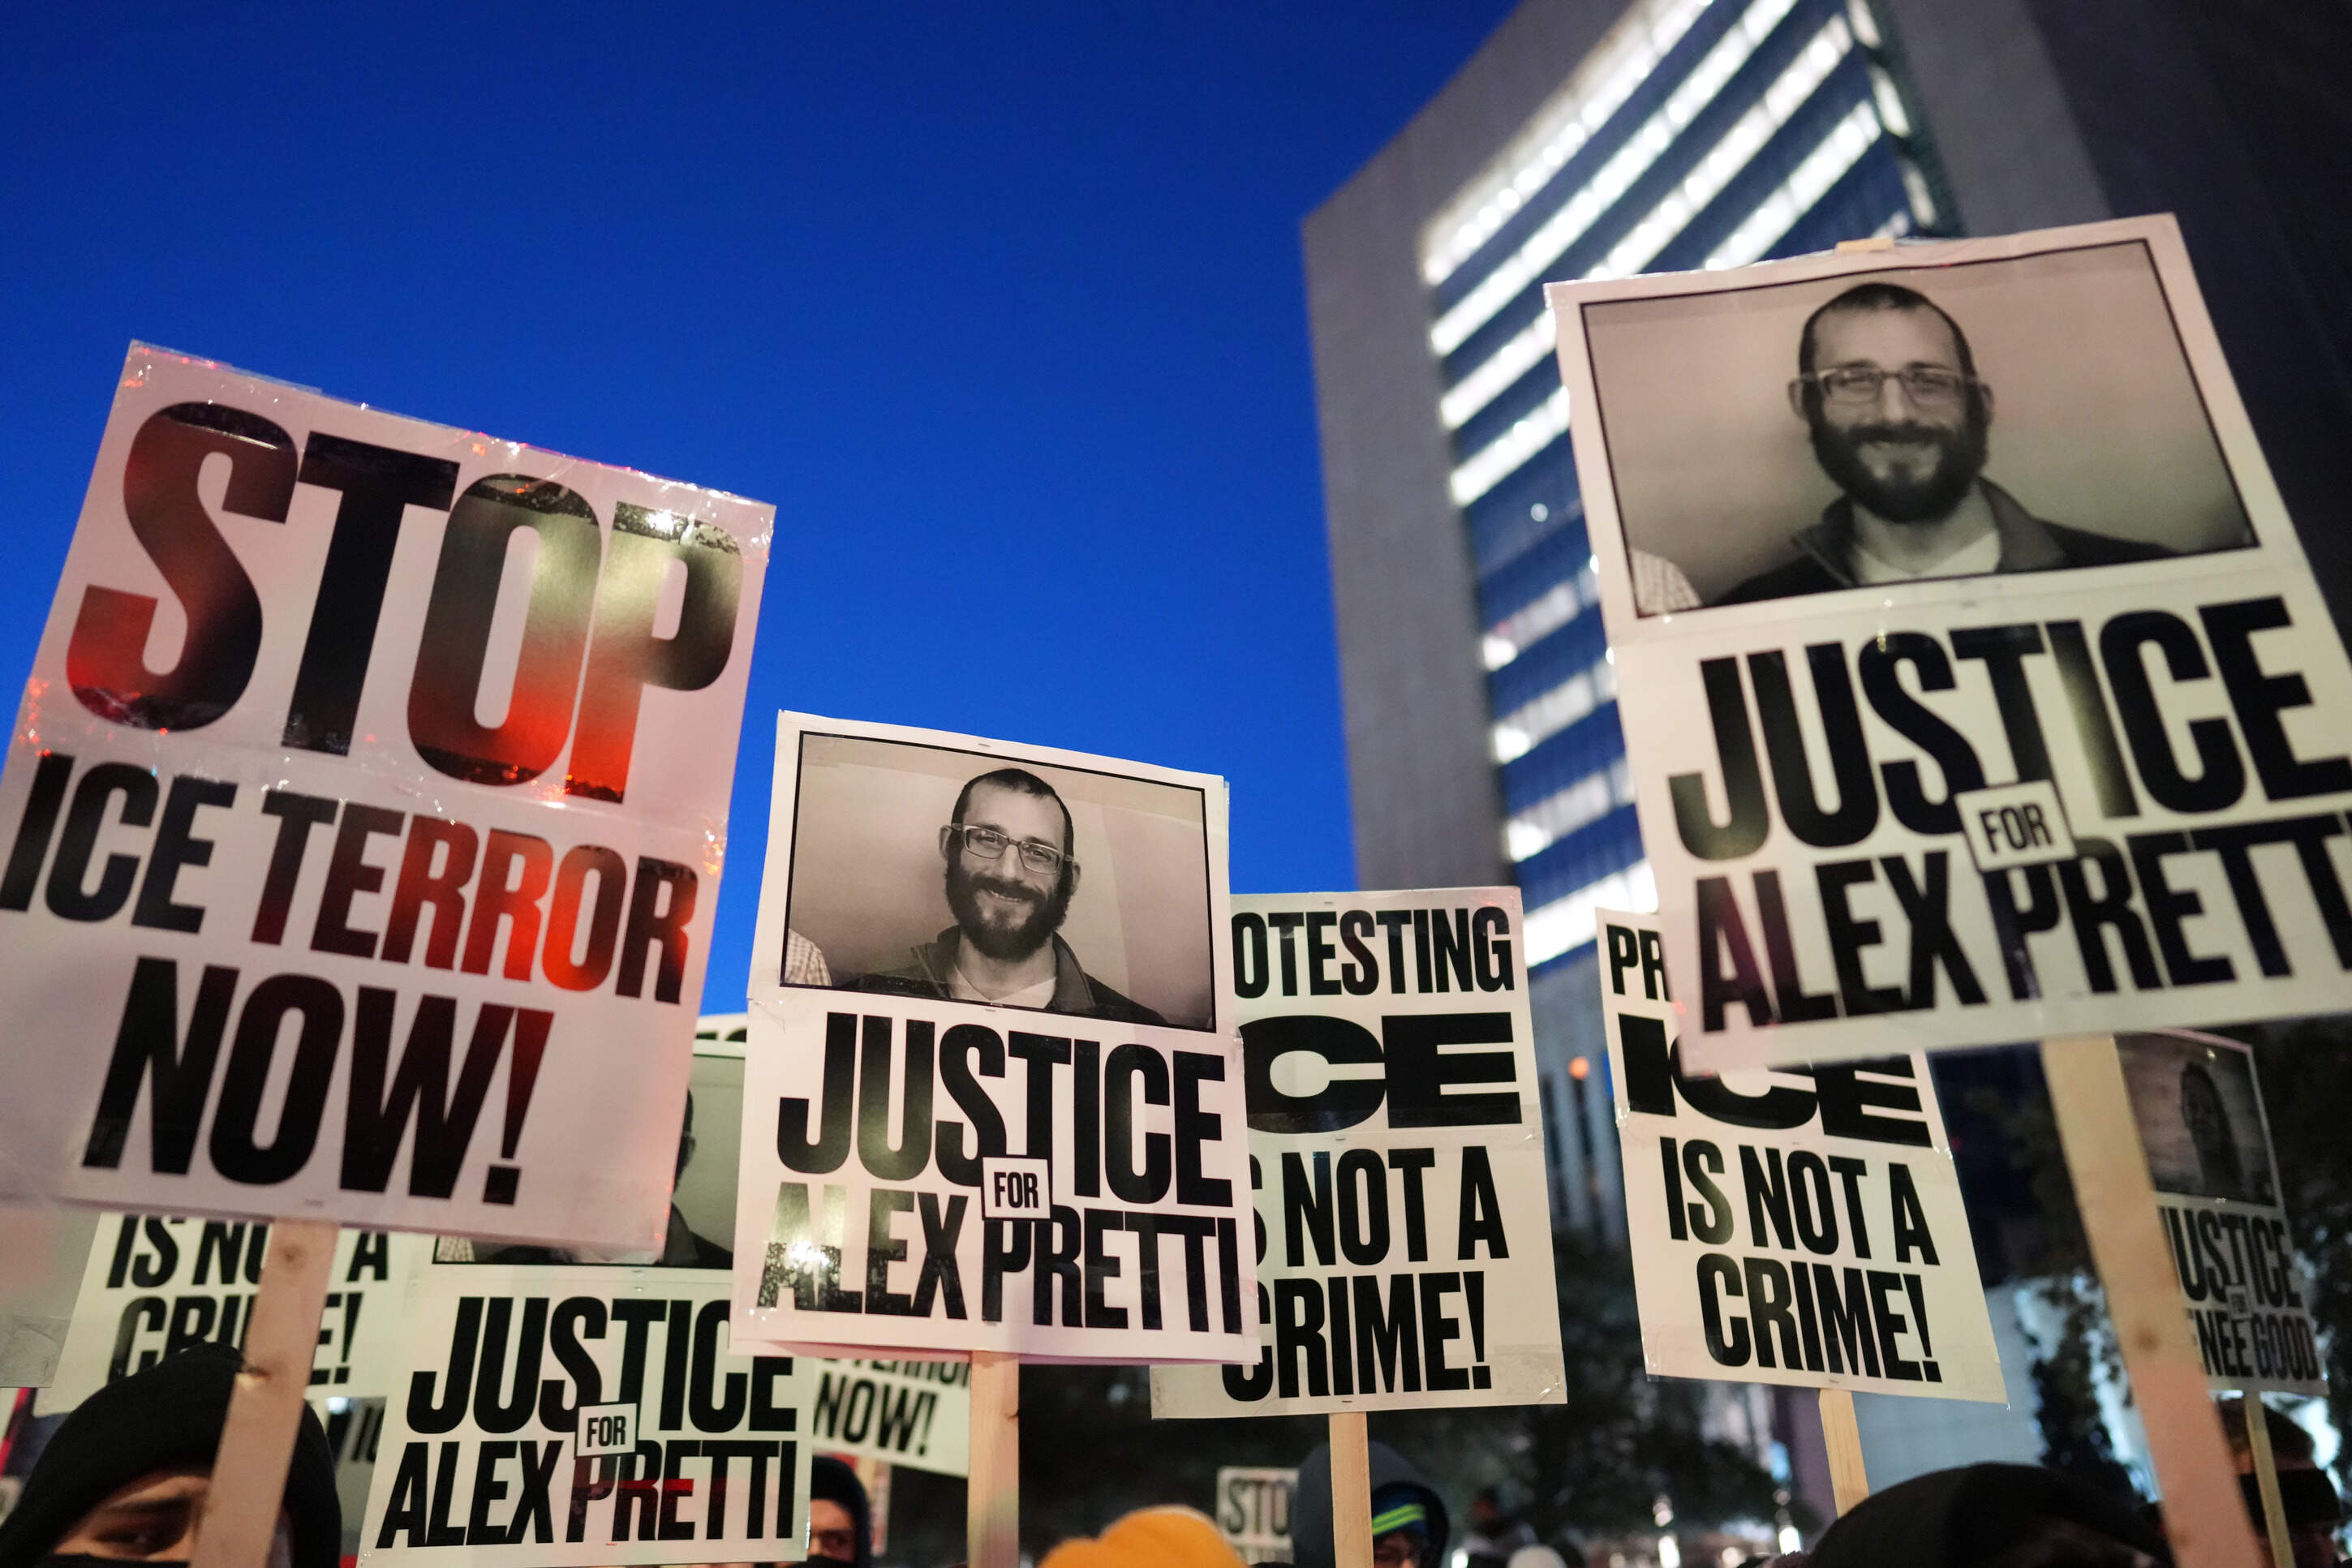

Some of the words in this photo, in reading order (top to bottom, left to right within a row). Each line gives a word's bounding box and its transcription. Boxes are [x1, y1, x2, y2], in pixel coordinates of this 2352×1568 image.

[67, 402, 743, 803] STOP
[1668, 595, 2352, 861] JUSTICE
[0, 753, 237, 935] ICE
[251, 791, 699, 1004] TERROR
[1980, 805, 2053, 855] FOR
[1696, 851, 1987, 1033] ALEX
[1985, 810, 2352, 1000] PRETT
[82, 957, 554, 1205] NOW!
[777, 1012, 1232, 1207] JUSTICE
[107, 1216, 184, 1288] IS
[348, 1232, 389, 1281] A
[994, 1171, 1038, 1209] FOR
[1282, 1148, 1435, 1267] NOT
[1458, 1145, 1509, 1260] A
[1660, 1137, 1734, 1245] IS
[1739, 1145, 1872, 1260] NOT
[1889, 1162, 1940, 1266] A
[757, 1181, 968, 1320] ALEX
[982, 1204, 1241, 1334] PRETTI
[1696, 1253, 1941, 1382] CRIME!
[2161, 1206, 2303, 1308] USTICE
[406, 1296, 798, 1434] JUSTICE
[2186, 1308, 2254, 1377] NEE
[2249, 1312, 2319, 1380] GOOD
[587, 1415, 626, 1449] FOR
[813, 1371, 938, 1457] NOW!
[376, 1440, 564, 1549] ALEX
[567, 1440, 798, 1543] PRETTI
